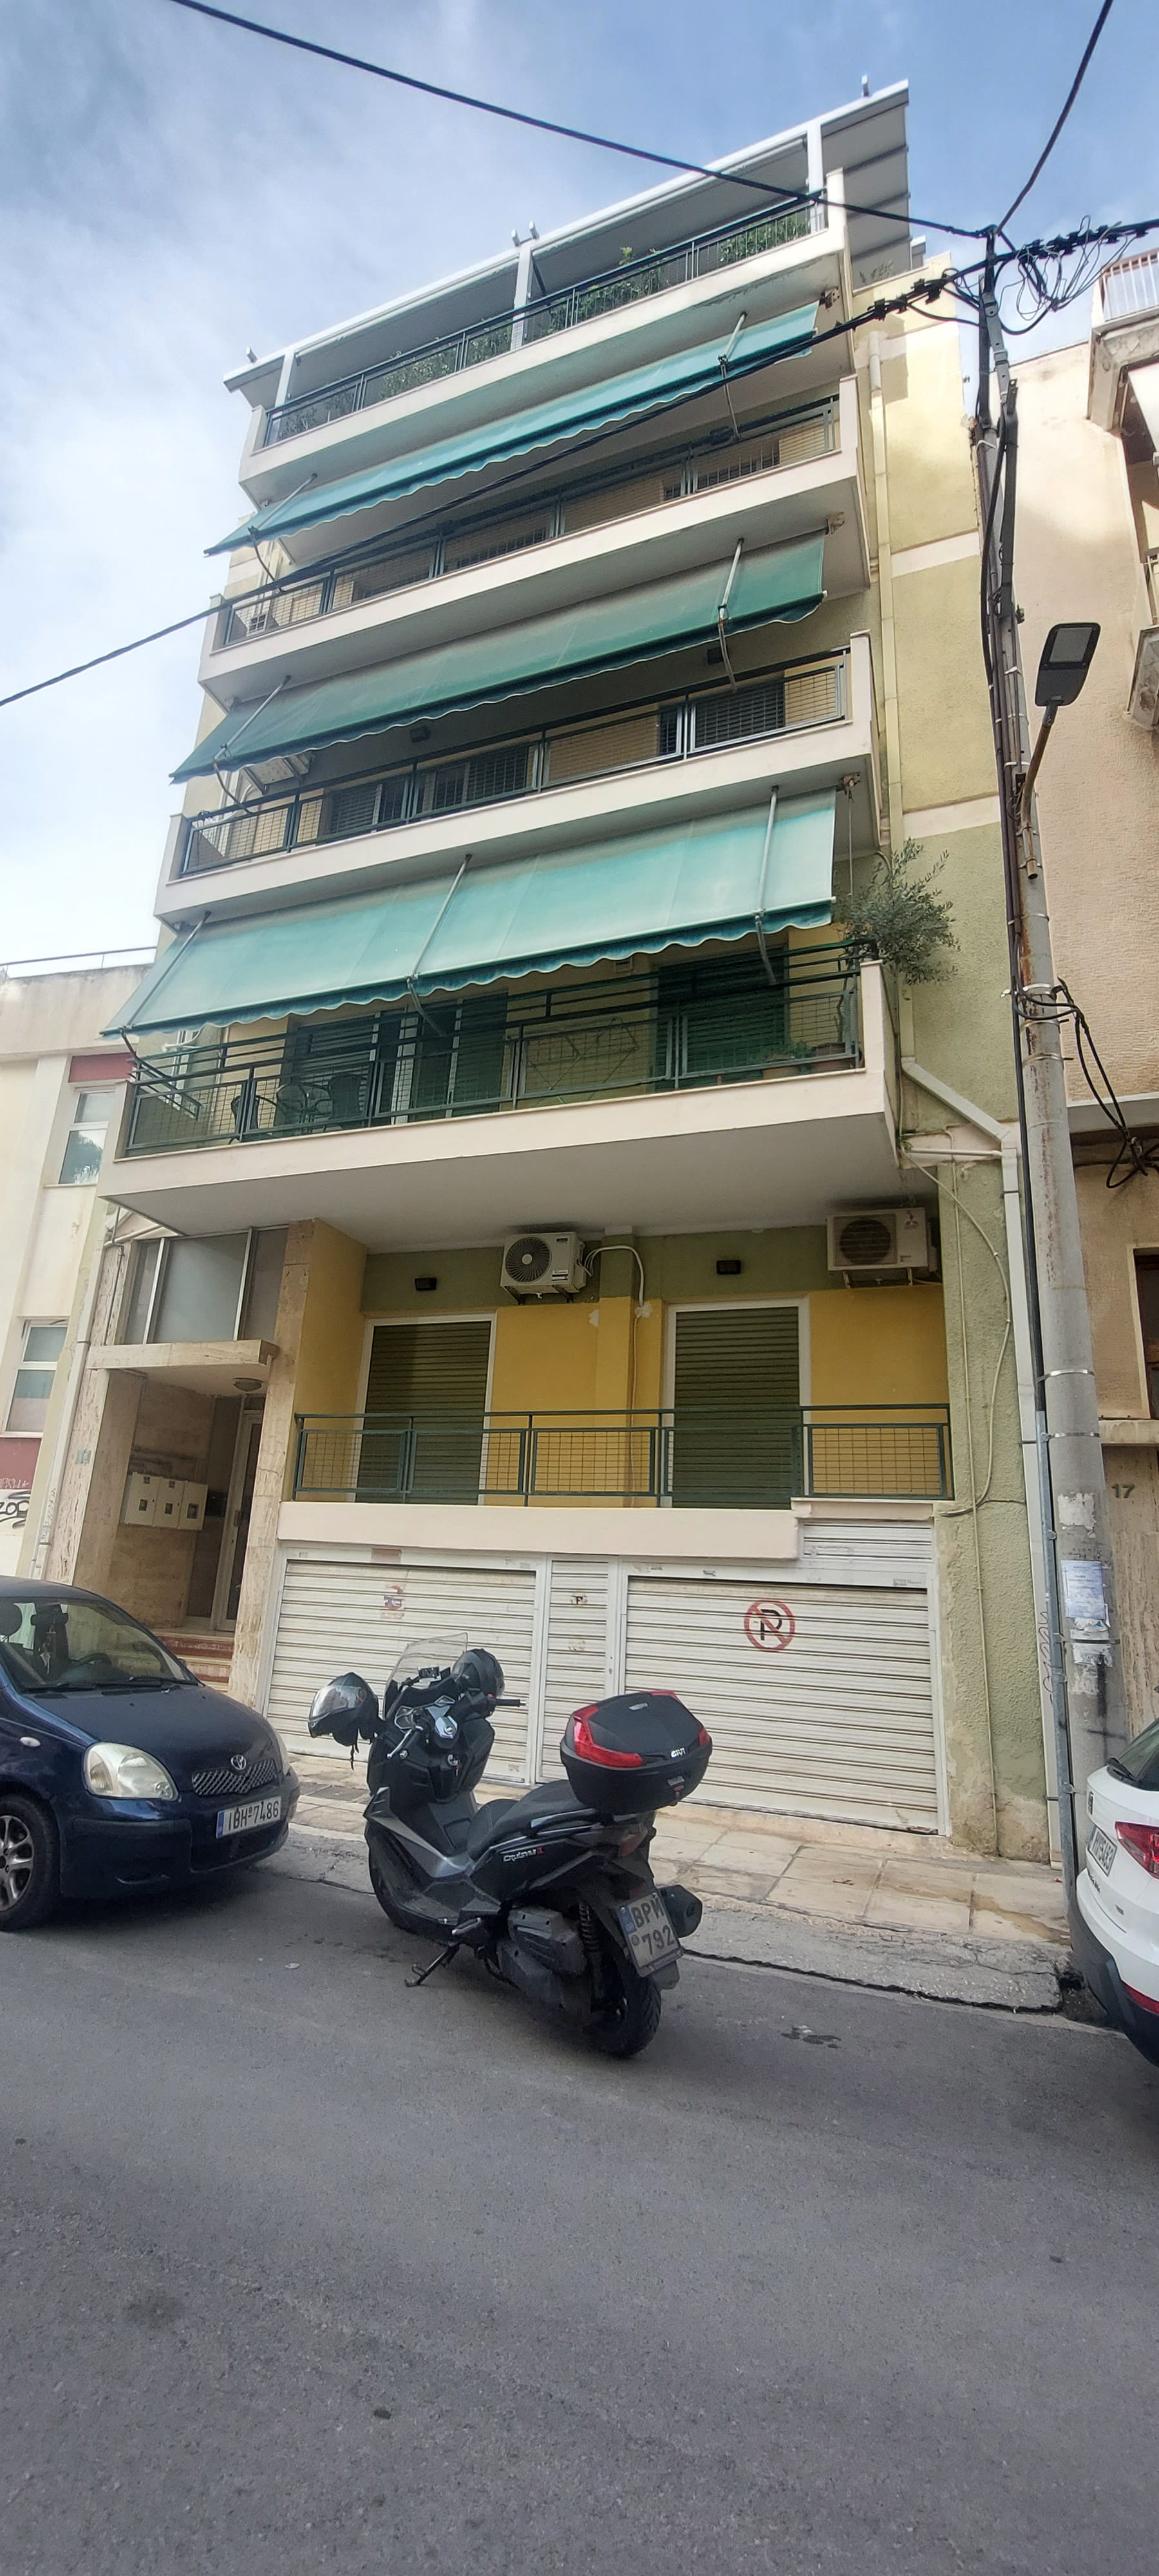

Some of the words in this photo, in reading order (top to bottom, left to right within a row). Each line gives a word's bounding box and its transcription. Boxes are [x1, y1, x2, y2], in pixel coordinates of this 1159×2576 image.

[1111, 1484, 1135, 1499] 17
[760, 1609, 782, 1640] P
[671, 1747, 686, 1757] GIVI
[641, 1924, 675, 1955] 792
